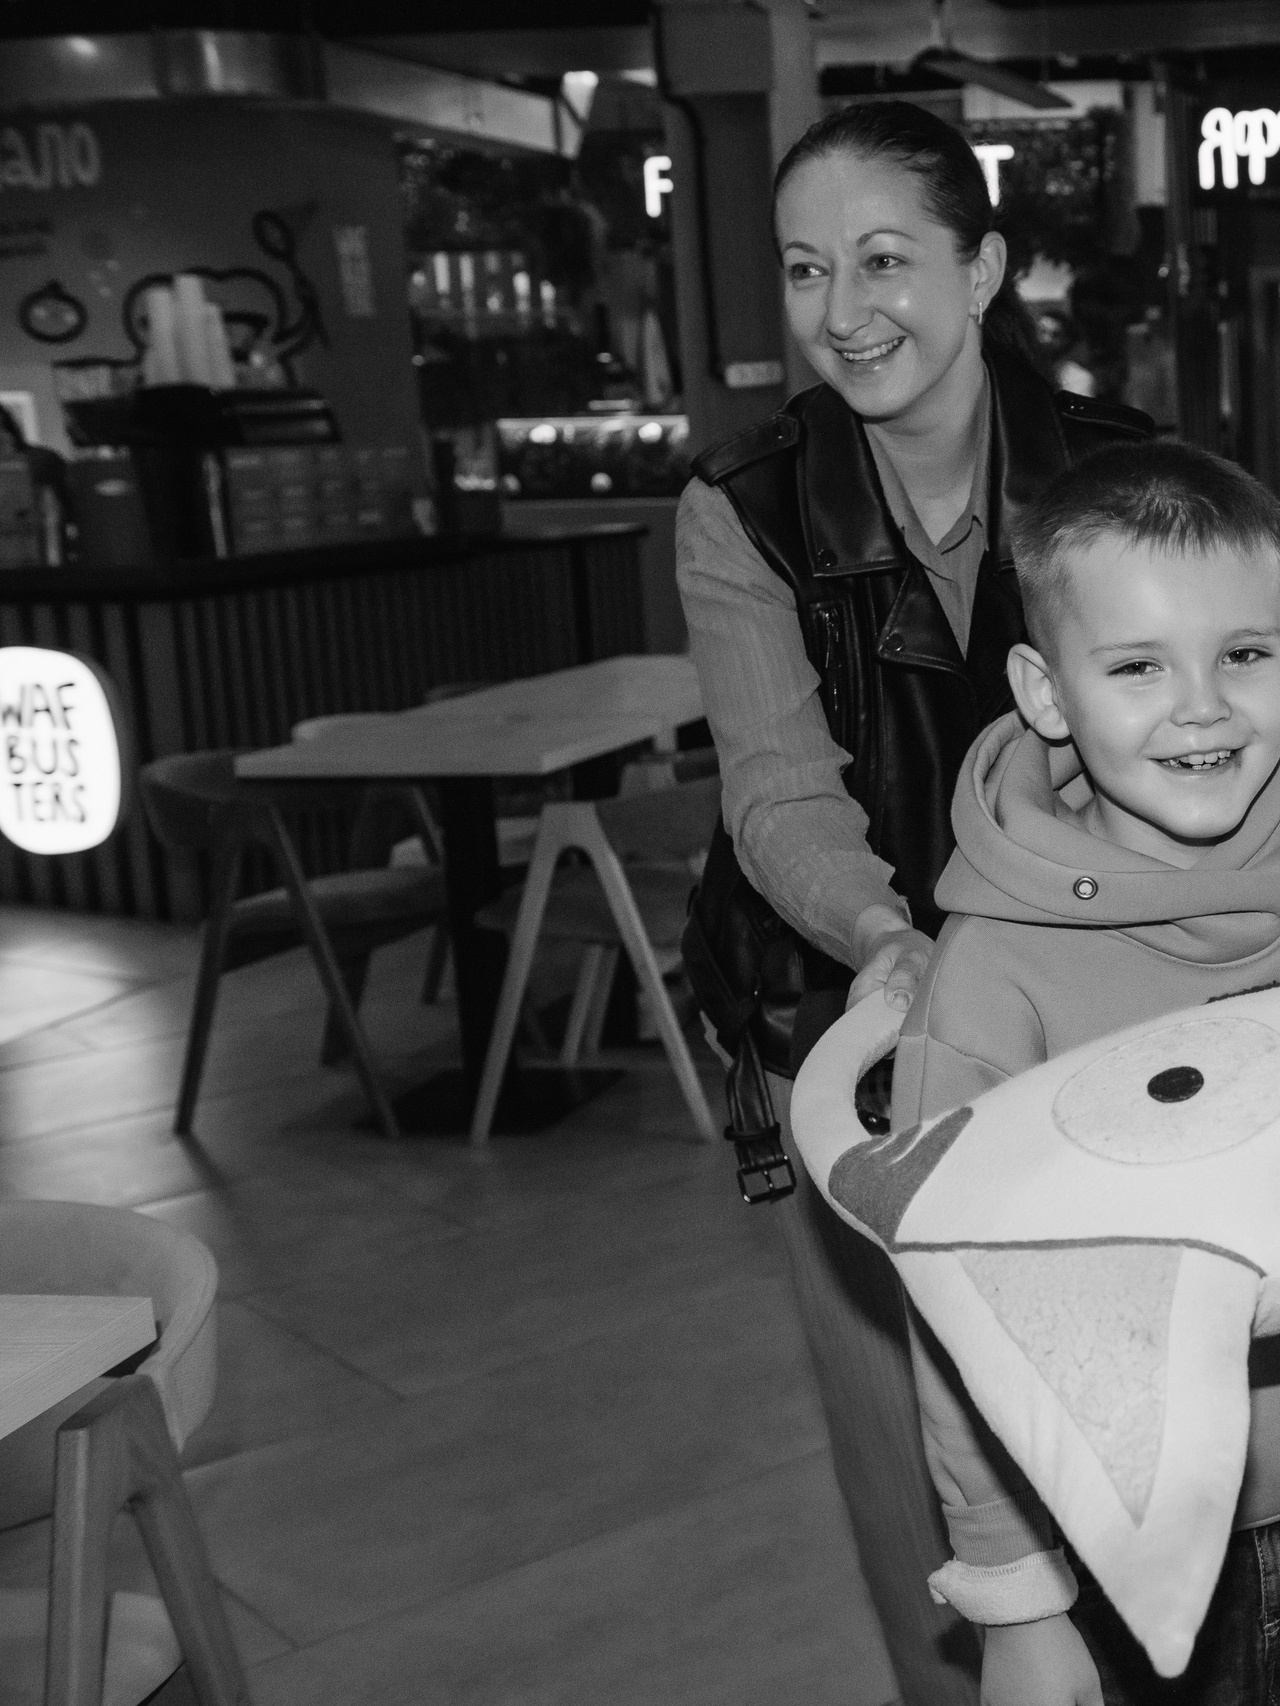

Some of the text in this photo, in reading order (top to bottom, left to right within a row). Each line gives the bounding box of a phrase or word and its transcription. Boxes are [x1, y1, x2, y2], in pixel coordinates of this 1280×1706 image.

[0, 683, 76, 730] WAF
[6, 735, 79, 777] BUS
[12, 782, 86, 823] TERS
